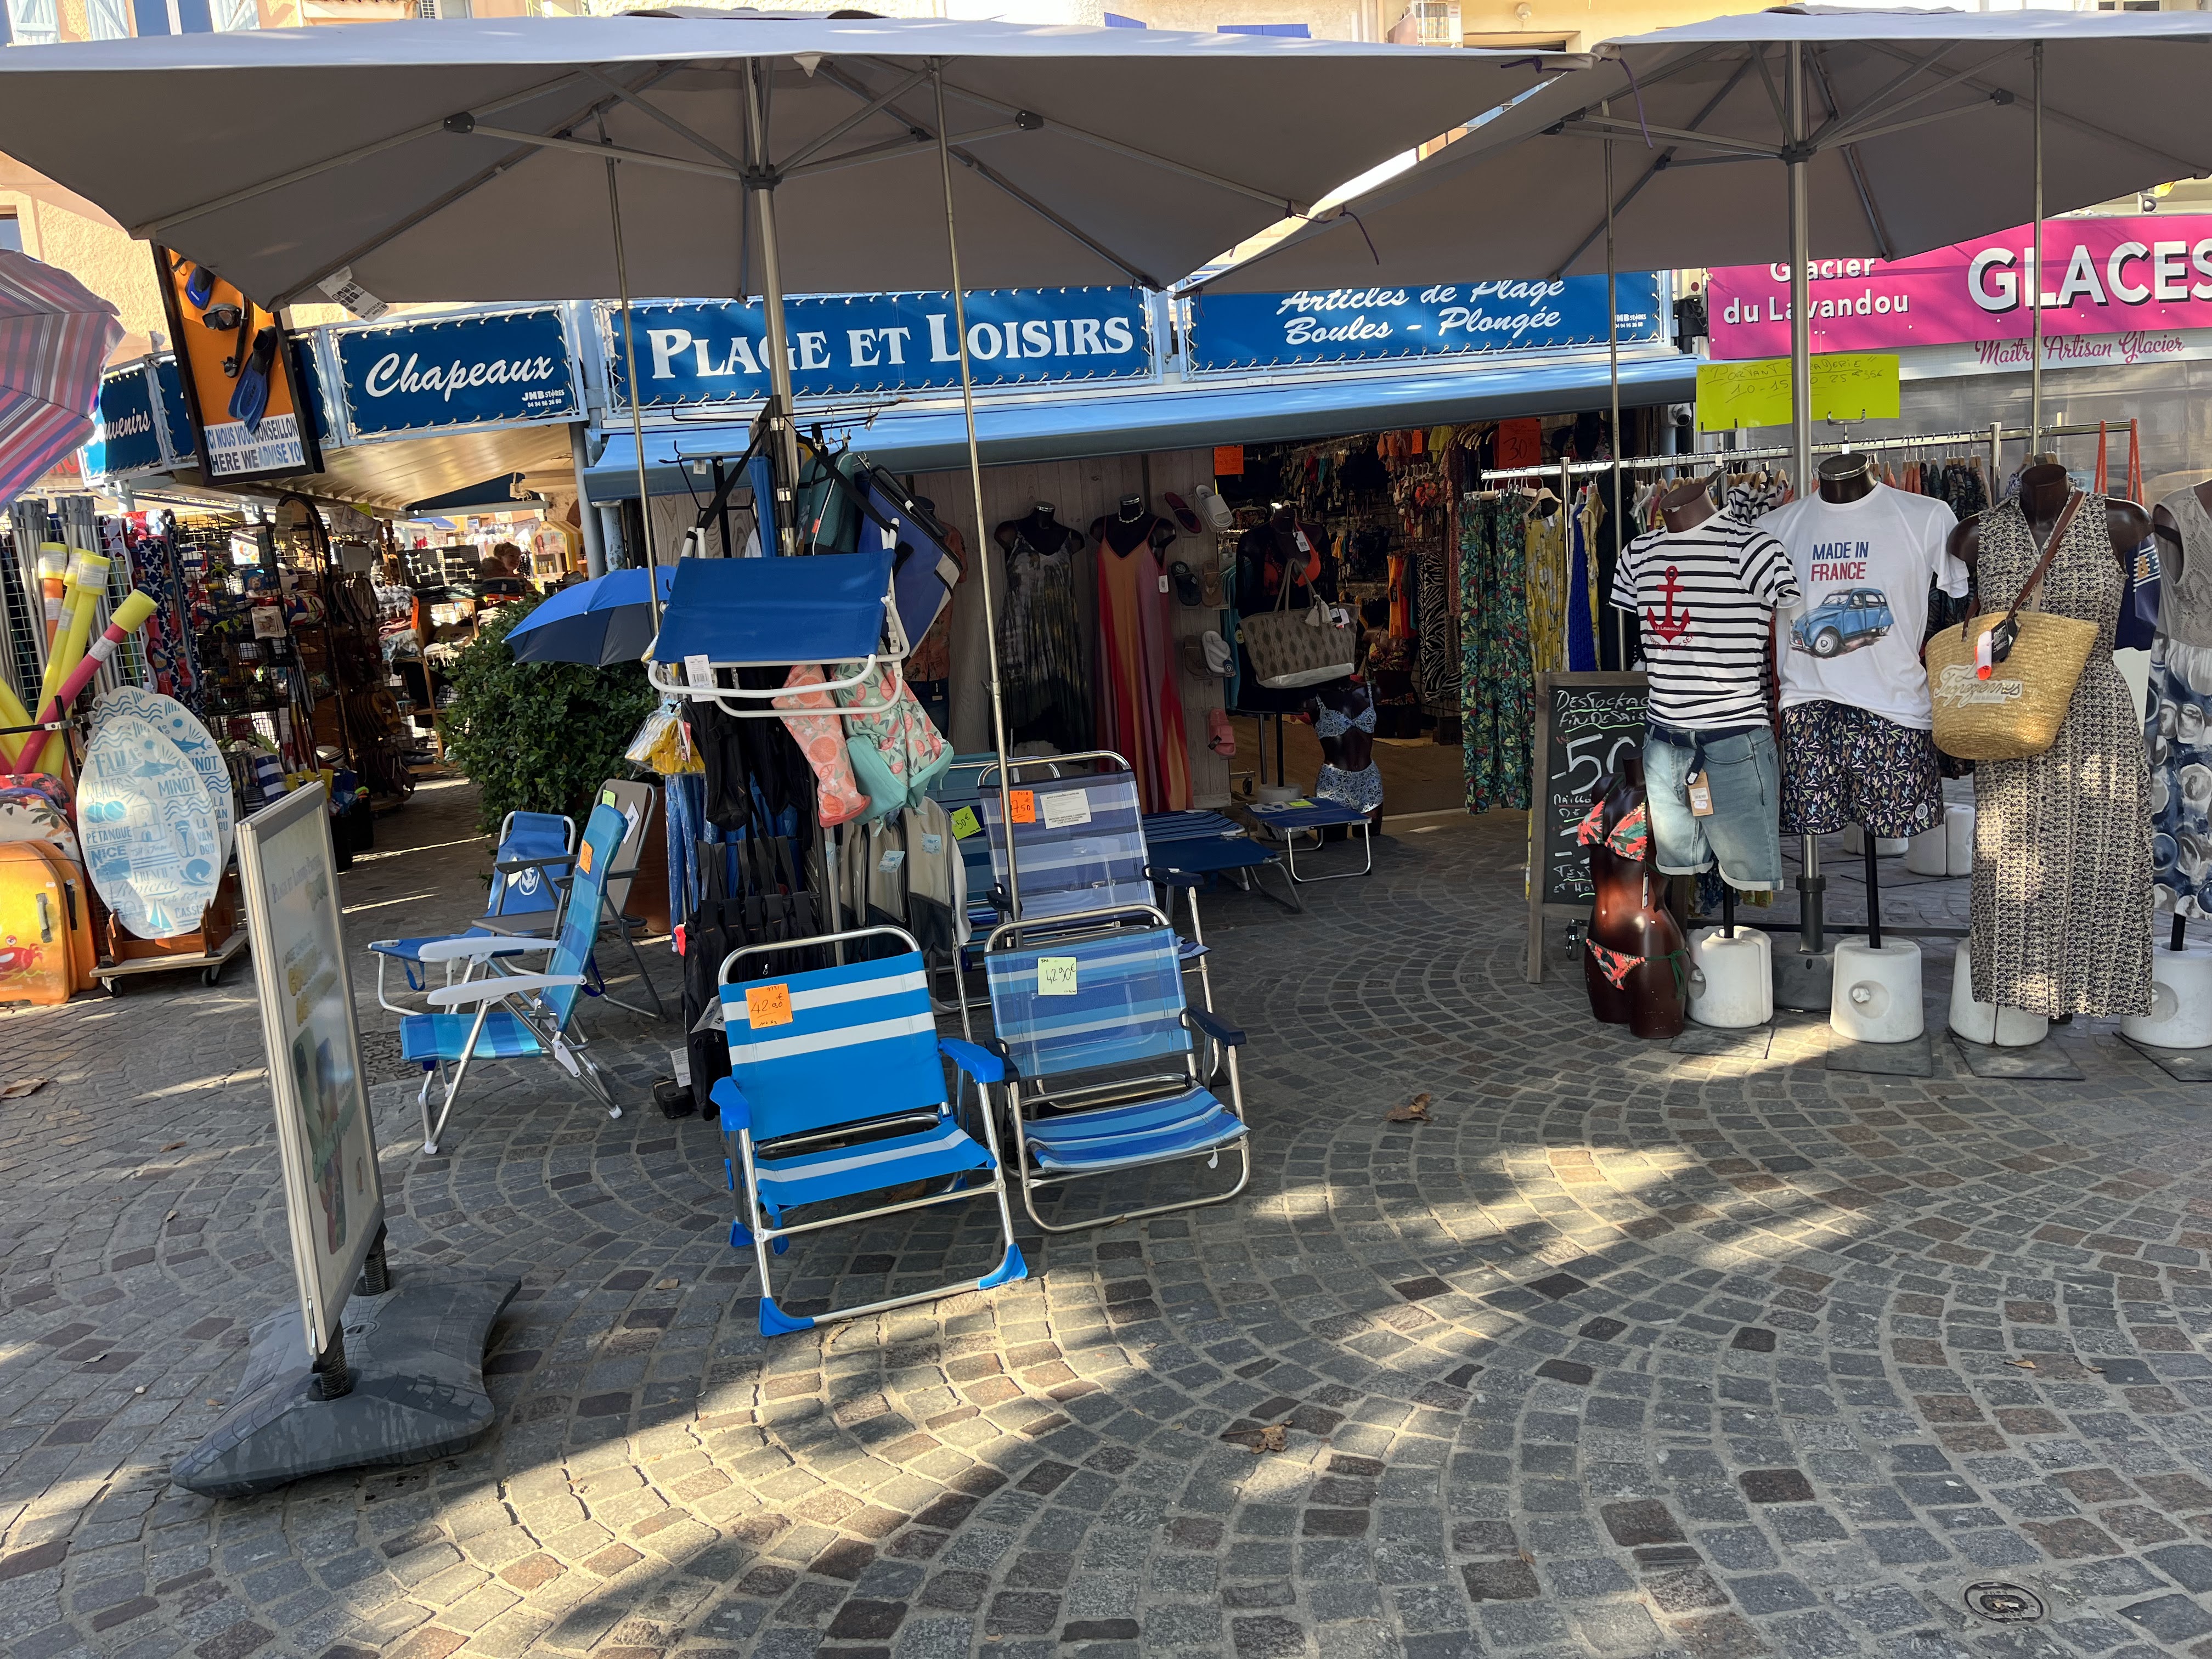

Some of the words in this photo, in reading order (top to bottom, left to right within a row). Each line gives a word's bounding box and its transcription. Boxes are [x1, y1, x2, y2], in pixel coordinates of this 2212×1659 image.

[1770, 258, 1875, 283] Gacier
[1968, 239, 2212, 312] GLACES
[1276, 288, 1409, 314] Articles
[1420, 284, 1457, 304] de
[1470, 279, 1565, 307] Plage
[1723, 297, 1759, 324] du
[1284, 315, 1393, 345] Boules
[1438, 305, 1561, 338] Plongée
[646, 329, 831, 379] PLAGE
[847, 327, 911, 367] ET
[926, 314, 1133, 362] LOISIRS
[2043, 335, 2113, 361] Artisan
[2119, 331, 2185, 364] Glacier
[365, 353, 554, 402] Chapeaux
[522, 391, 545, 401] JMB
[545, 389, 565, 398] STORES
[215, 426, 236, 449] NOUS
[210, 452, 241, 473] HERE
[241, 449, 259, 469] WE
[258, 443, 289, 466] ADVISE
[1812, 542, 1852, 560] MADE
[1855, 541, 1869, 558] IN
[1811, 561, 1867, 582] FRANCE
[84, 777, 124, 800] CIGALES
[157, 776, 196, 797] MINOT
[213, 797, 224, 806] LA
[198, 818, 208, 829] LA
[219, 821, 228, 832] OU
[196, 830, 213, 842] VAN
[89, 845, 127, 868] NICE
[200, 844, 215, 855] DOU
[116, 879, 179, 898] Riviera
[174, 905, 204, 919] CASSIS
